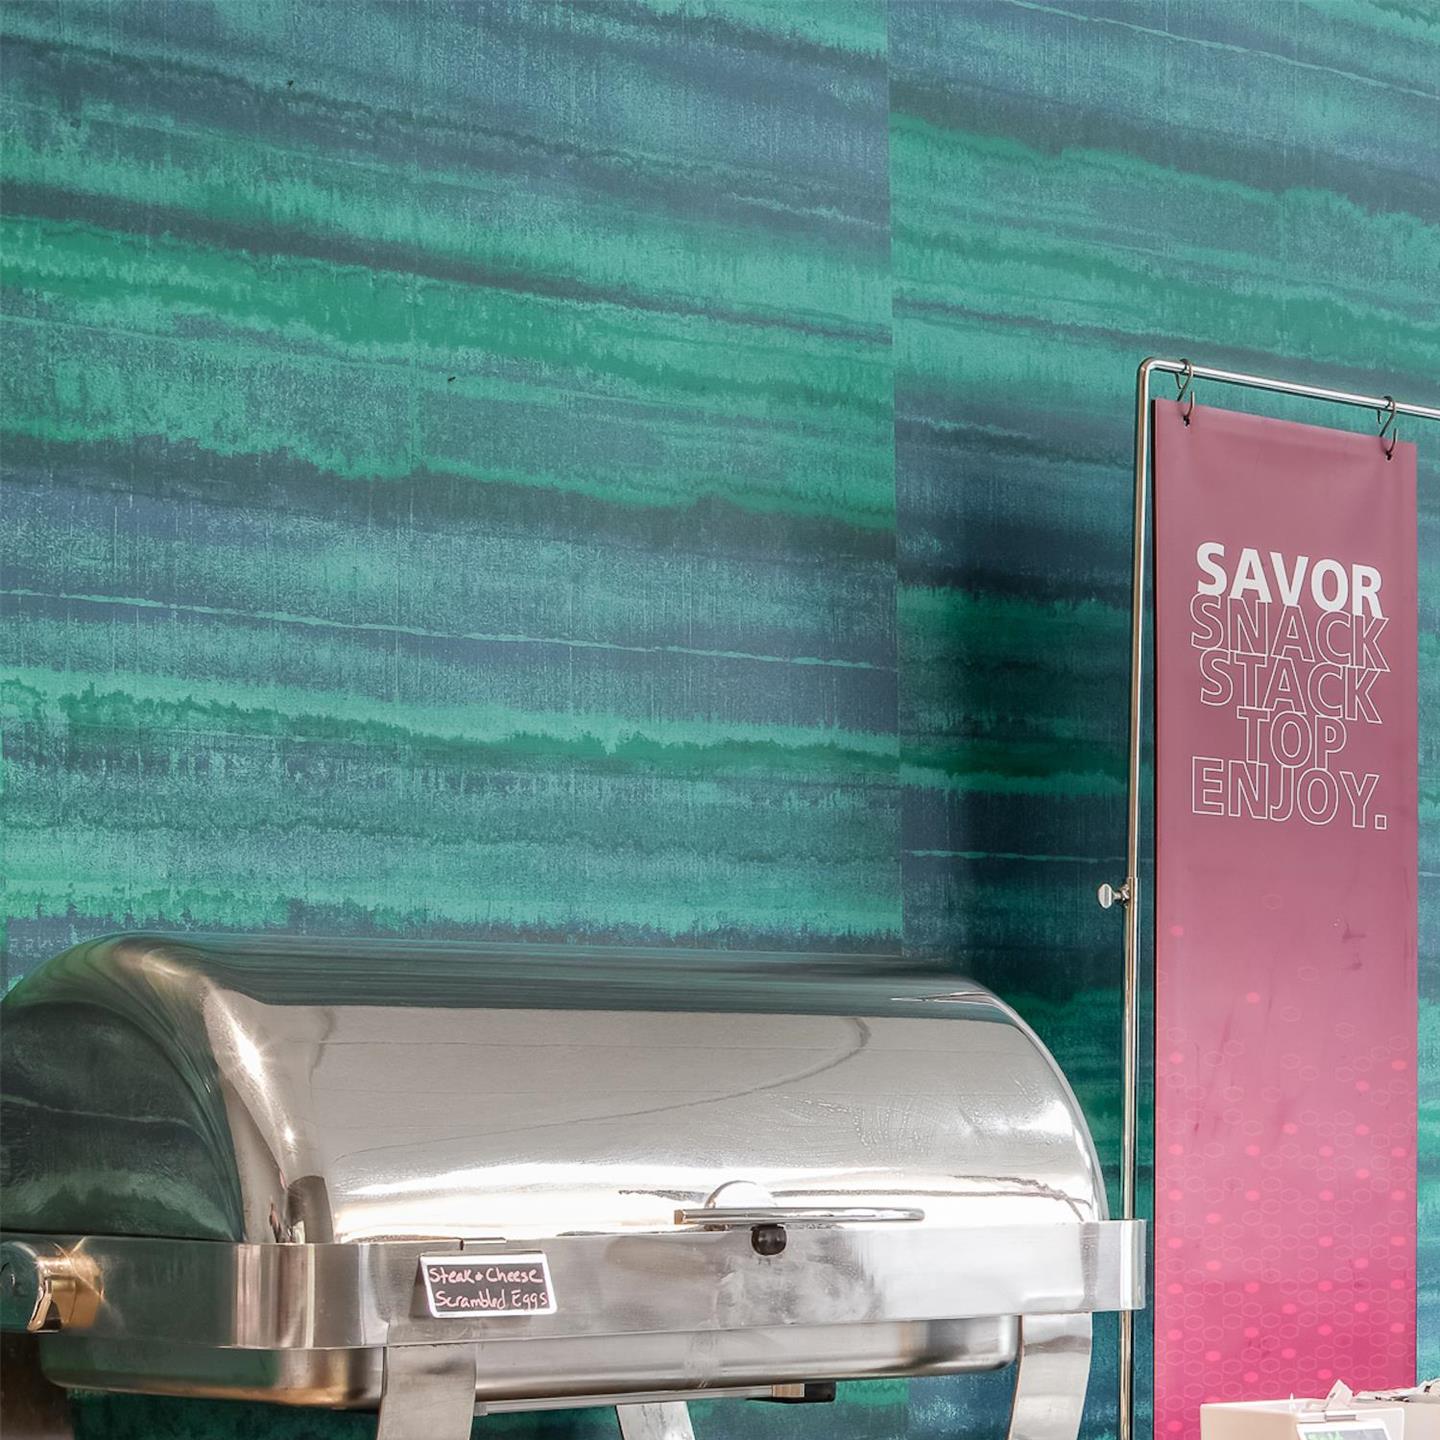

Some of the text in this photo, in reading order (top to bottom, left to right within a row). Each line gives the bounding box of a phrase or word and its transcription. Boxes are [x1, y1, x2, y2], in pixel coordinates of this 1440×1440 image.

[1196, 541, 1383, 618] SAVOR
[1190, 593, 1390, 672] SNACK
[1199, 647, 1383, 724] STACK
[1236, 706, 1347, 770] TOP
[1191, 756, 1388, 830] ENJOY.
[428, 1268, 475, 1284] Steak
[485, 1268, 544, 1283] Cheese
[435, 1288, 549, 1311] Scrambled Eggs
